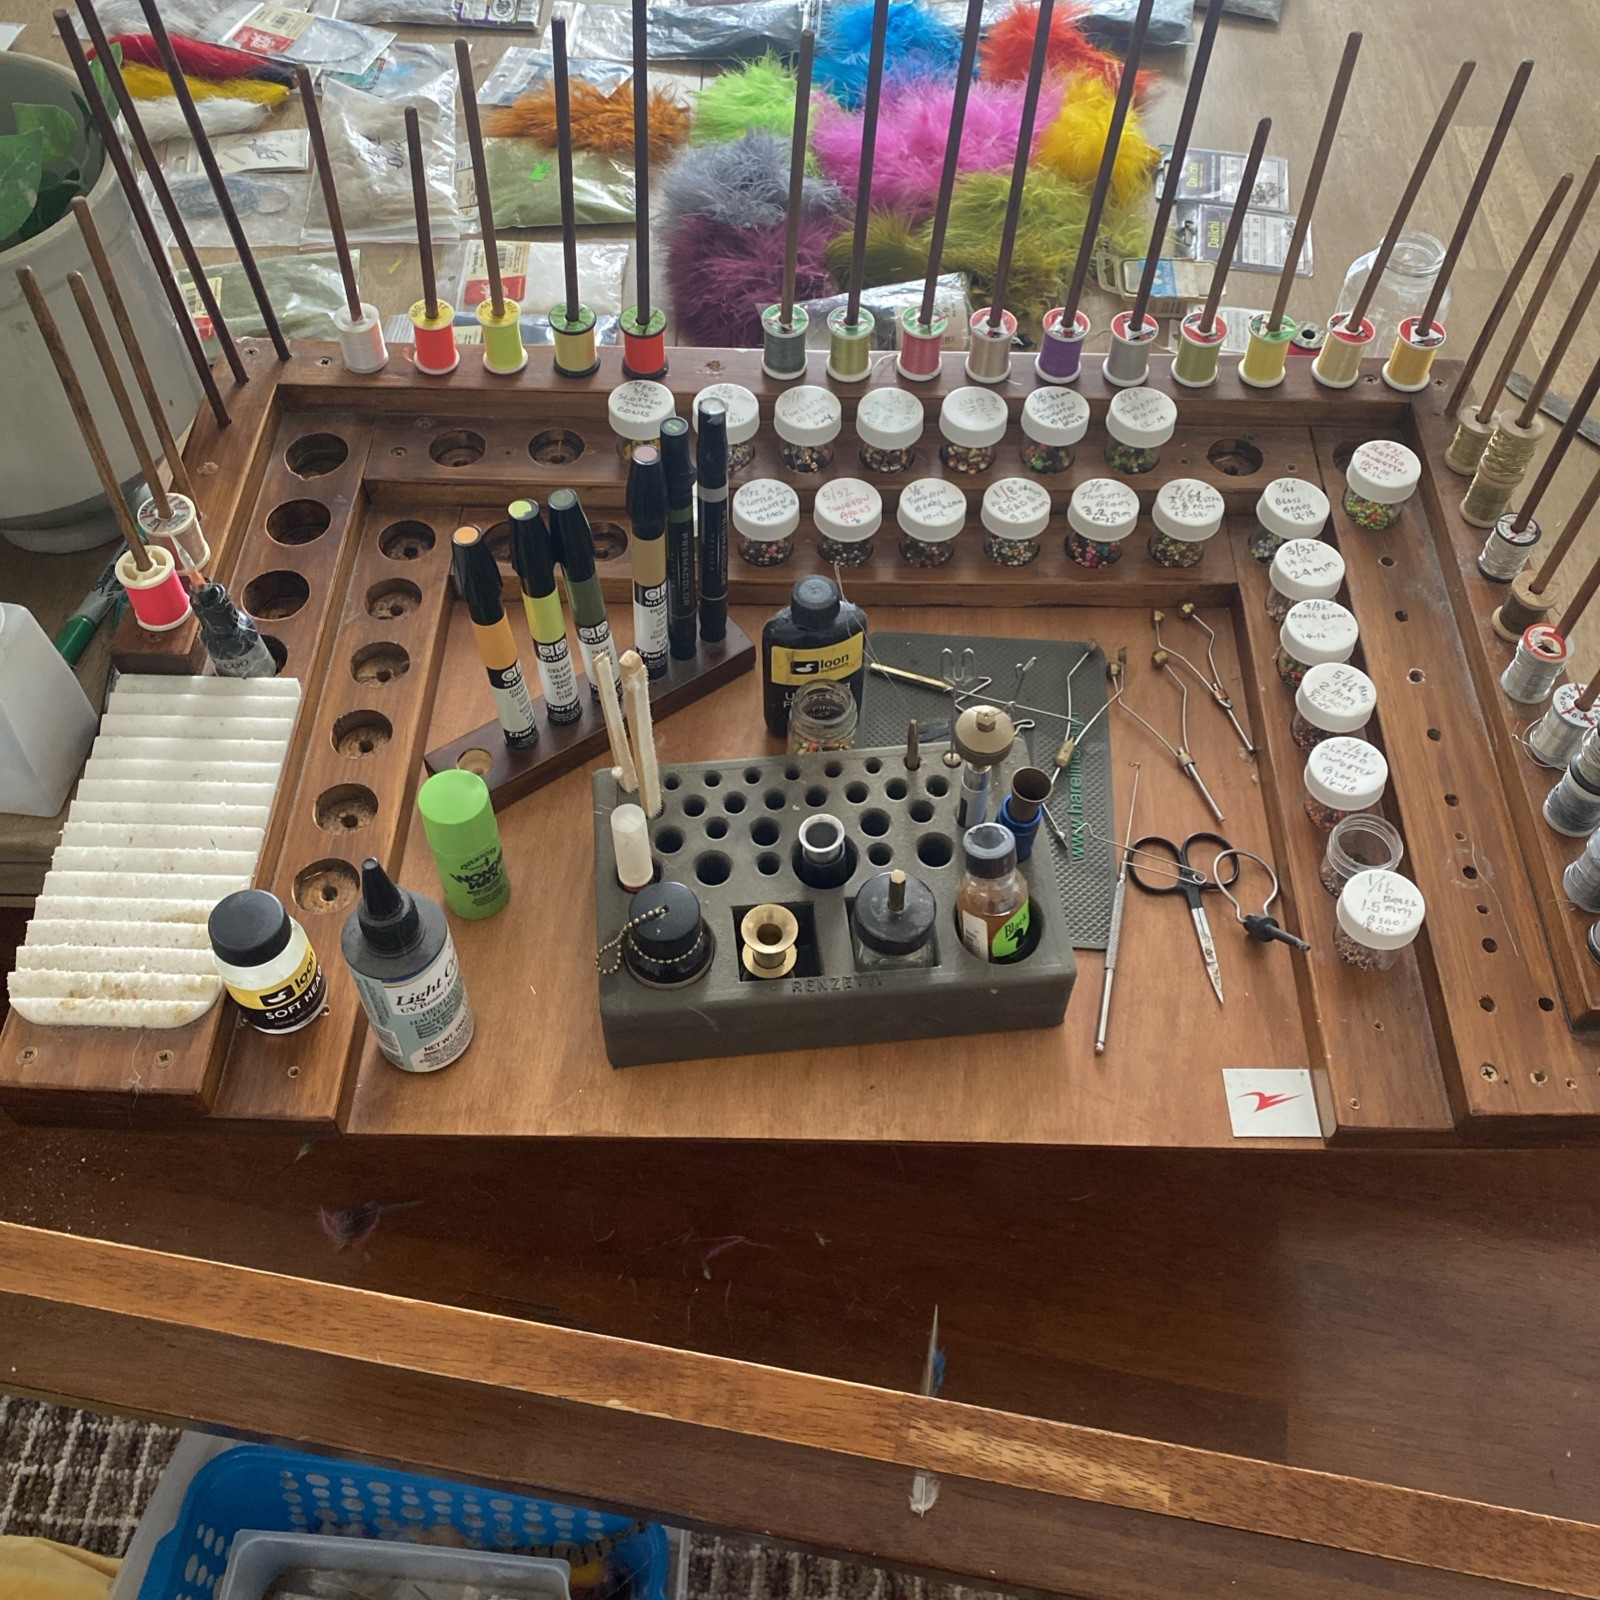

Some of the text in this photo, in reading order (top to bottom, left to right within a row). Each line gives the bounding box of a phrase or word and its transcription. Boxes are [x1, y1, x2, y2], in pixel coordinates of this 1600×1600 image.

[1208, 221, 1220, 248] Daiichi
[682, 532, 691, 606] PRISMACOLOR
[1312, 561, 1338, 573] mm
[582, 632, 611, 644] MARKE
[820, 654, 849, 669] loon
[1330, 689, 1356, 706] mm
[1368, 873, 1394, 895] 1/16
[1361, 898, 1412, 918] 1.5 mm
[295, 951, 314, 989] loon
[396, 978, 442, 1008] Light
[400, 1005, 418, 1015] UV
[419, 991, 444, 1010] Resin
[265, 1000, 301, 1020] SOFT
[424, 1043, 441, 1052] NET
